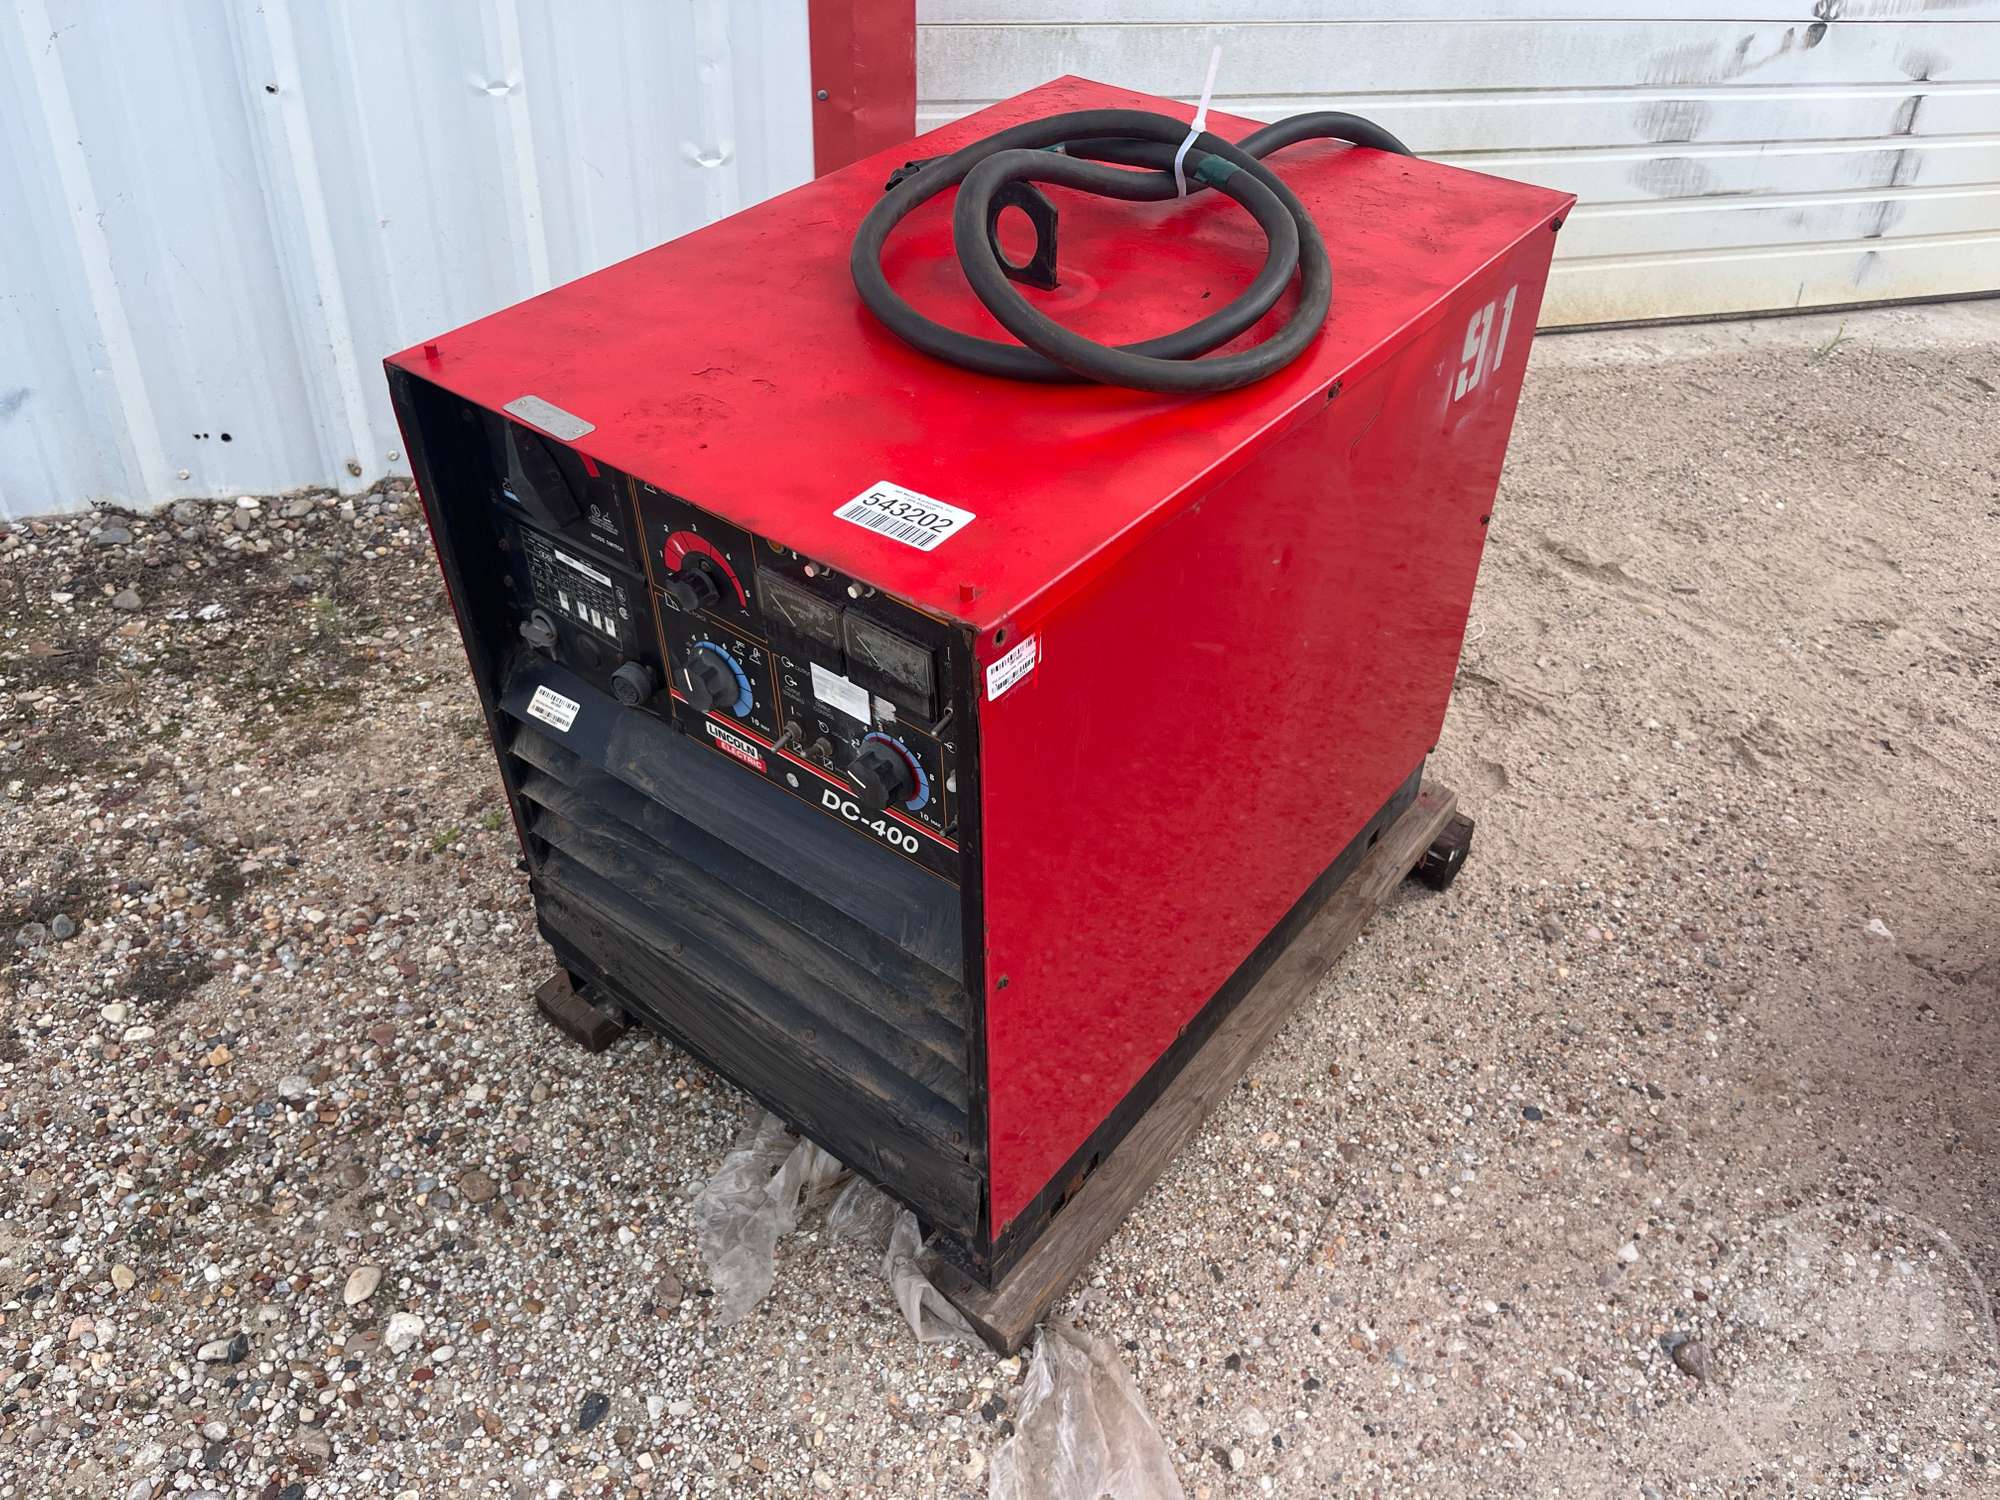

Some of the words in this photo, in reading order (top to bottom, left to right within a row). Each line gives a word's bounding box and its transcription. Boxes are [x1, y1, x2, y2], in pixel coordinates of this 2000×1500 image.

[1454, 284, 1518, 402] 91
[863, 492, 954, 533] 543202
[708, 724, 757, 757] LINCOLN
[720, 741, 763, 769] ELECTRIC
[821, 788, 919, 854] DC-400
